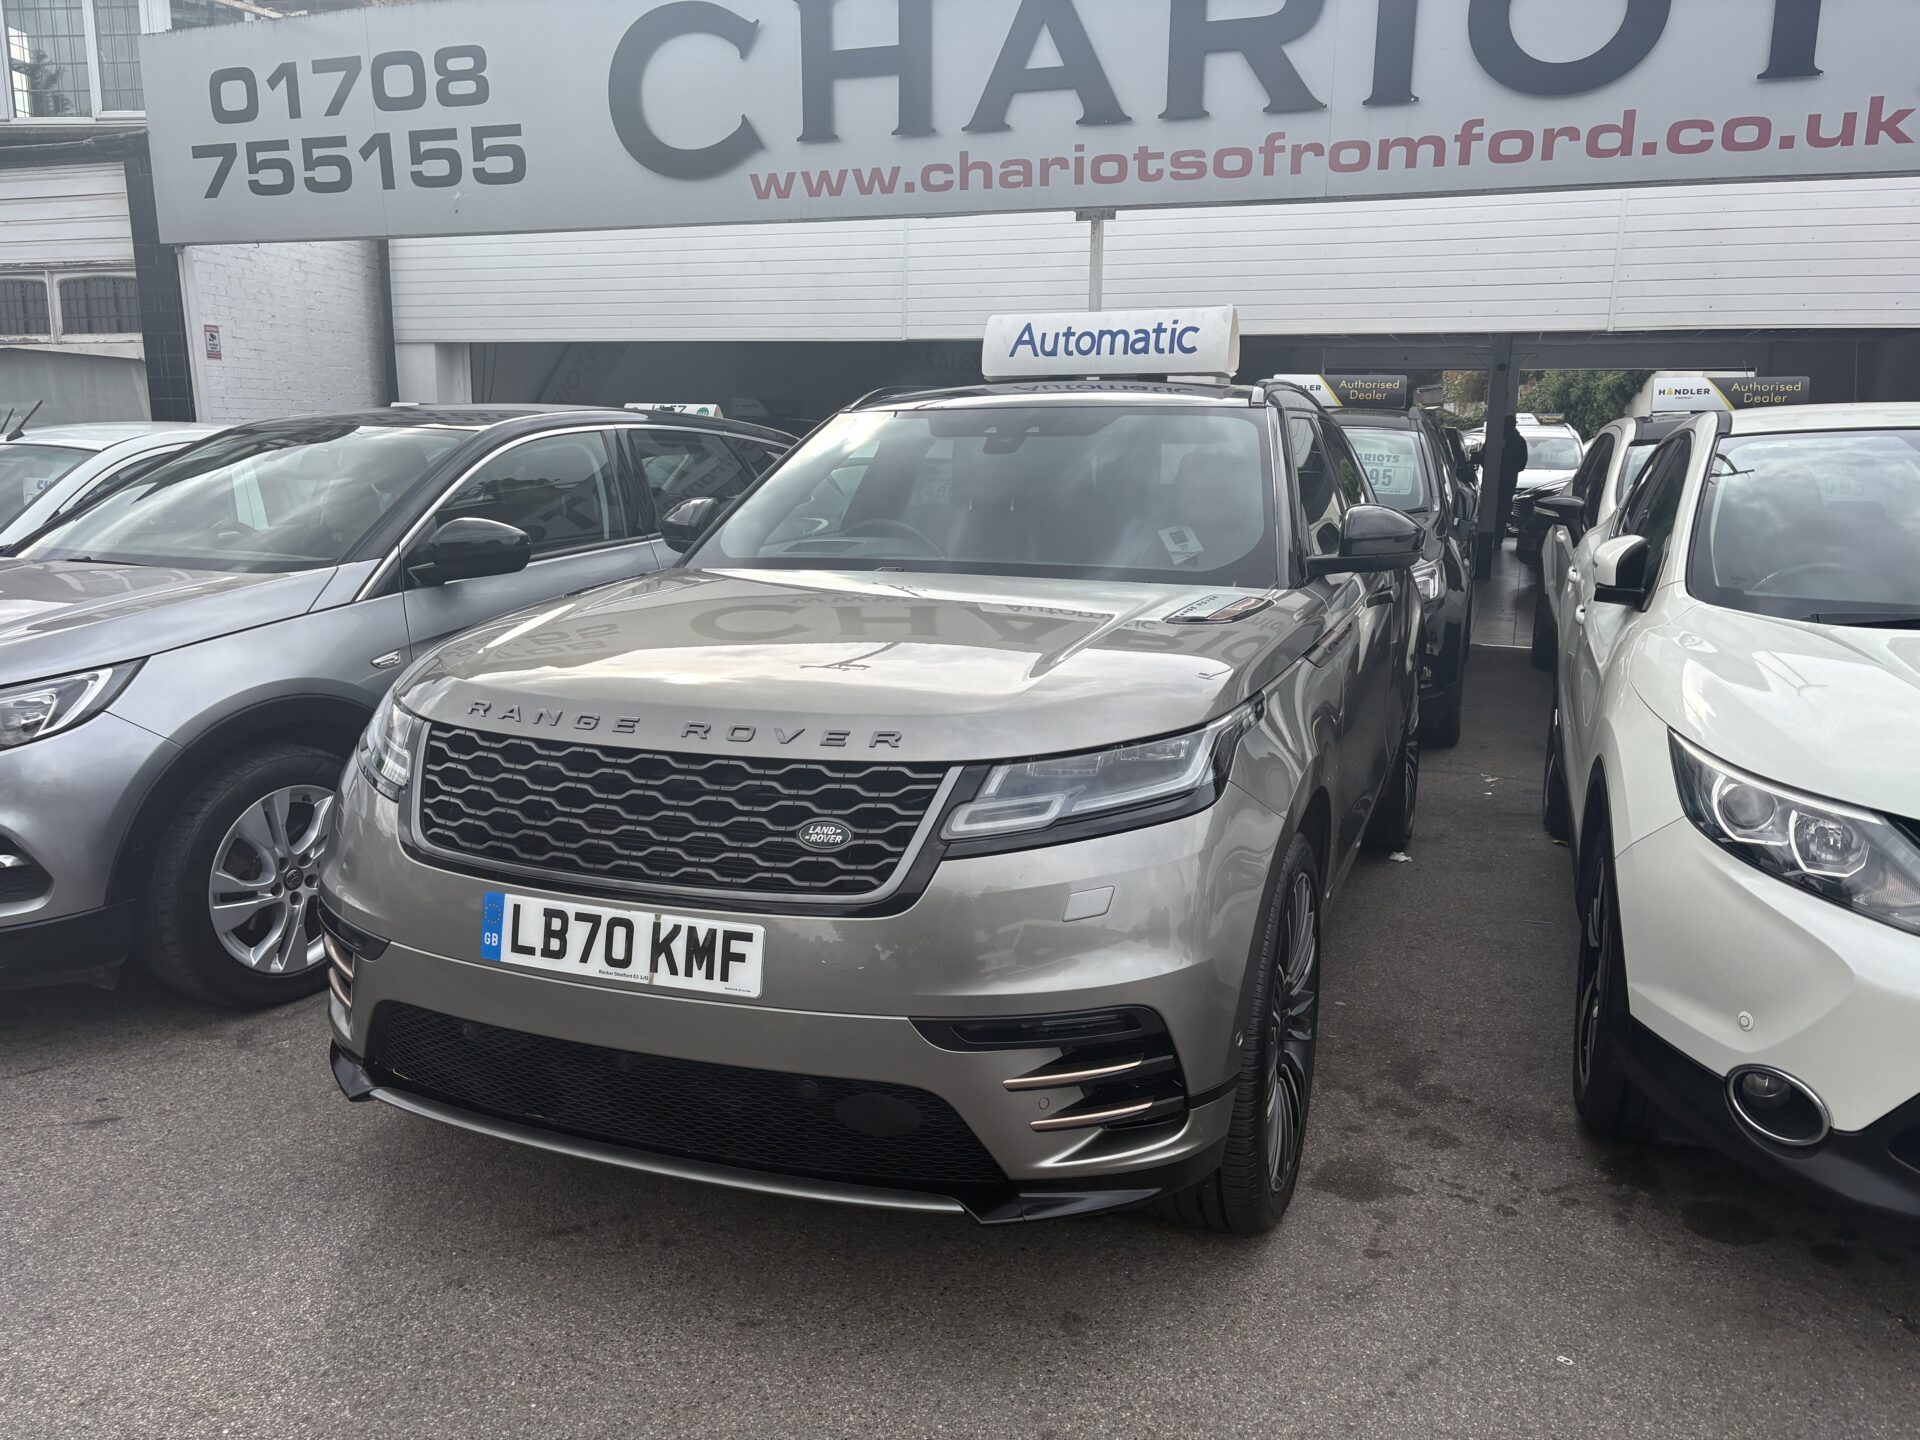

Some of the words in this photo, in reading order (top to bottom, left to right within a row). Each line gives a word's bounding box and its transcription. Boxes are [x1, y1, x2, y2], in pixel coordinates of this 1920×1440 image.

[209, 44, 490, 125] 01708
[190, 123, 527, 200] 755155
[749, 95, 1917, 201] www.chariotsofromford.co.uk
[1008, 319, 1201, 358] Automatic
[1339, 379, 1400, 390] Authorised
[1349, 389, 1388, 400] Dealer
[1731, 381, 1802, 393] Authorised
[1743, 392, 1788, 403] Dealer
[467, 700, 640, 734] RANGE
[680, 720, 903, 749] ROVER
[484, 931, 499, 947] GB
[510, 903, 635, 970] LB70
[649, 921, 754, 983] KMF
